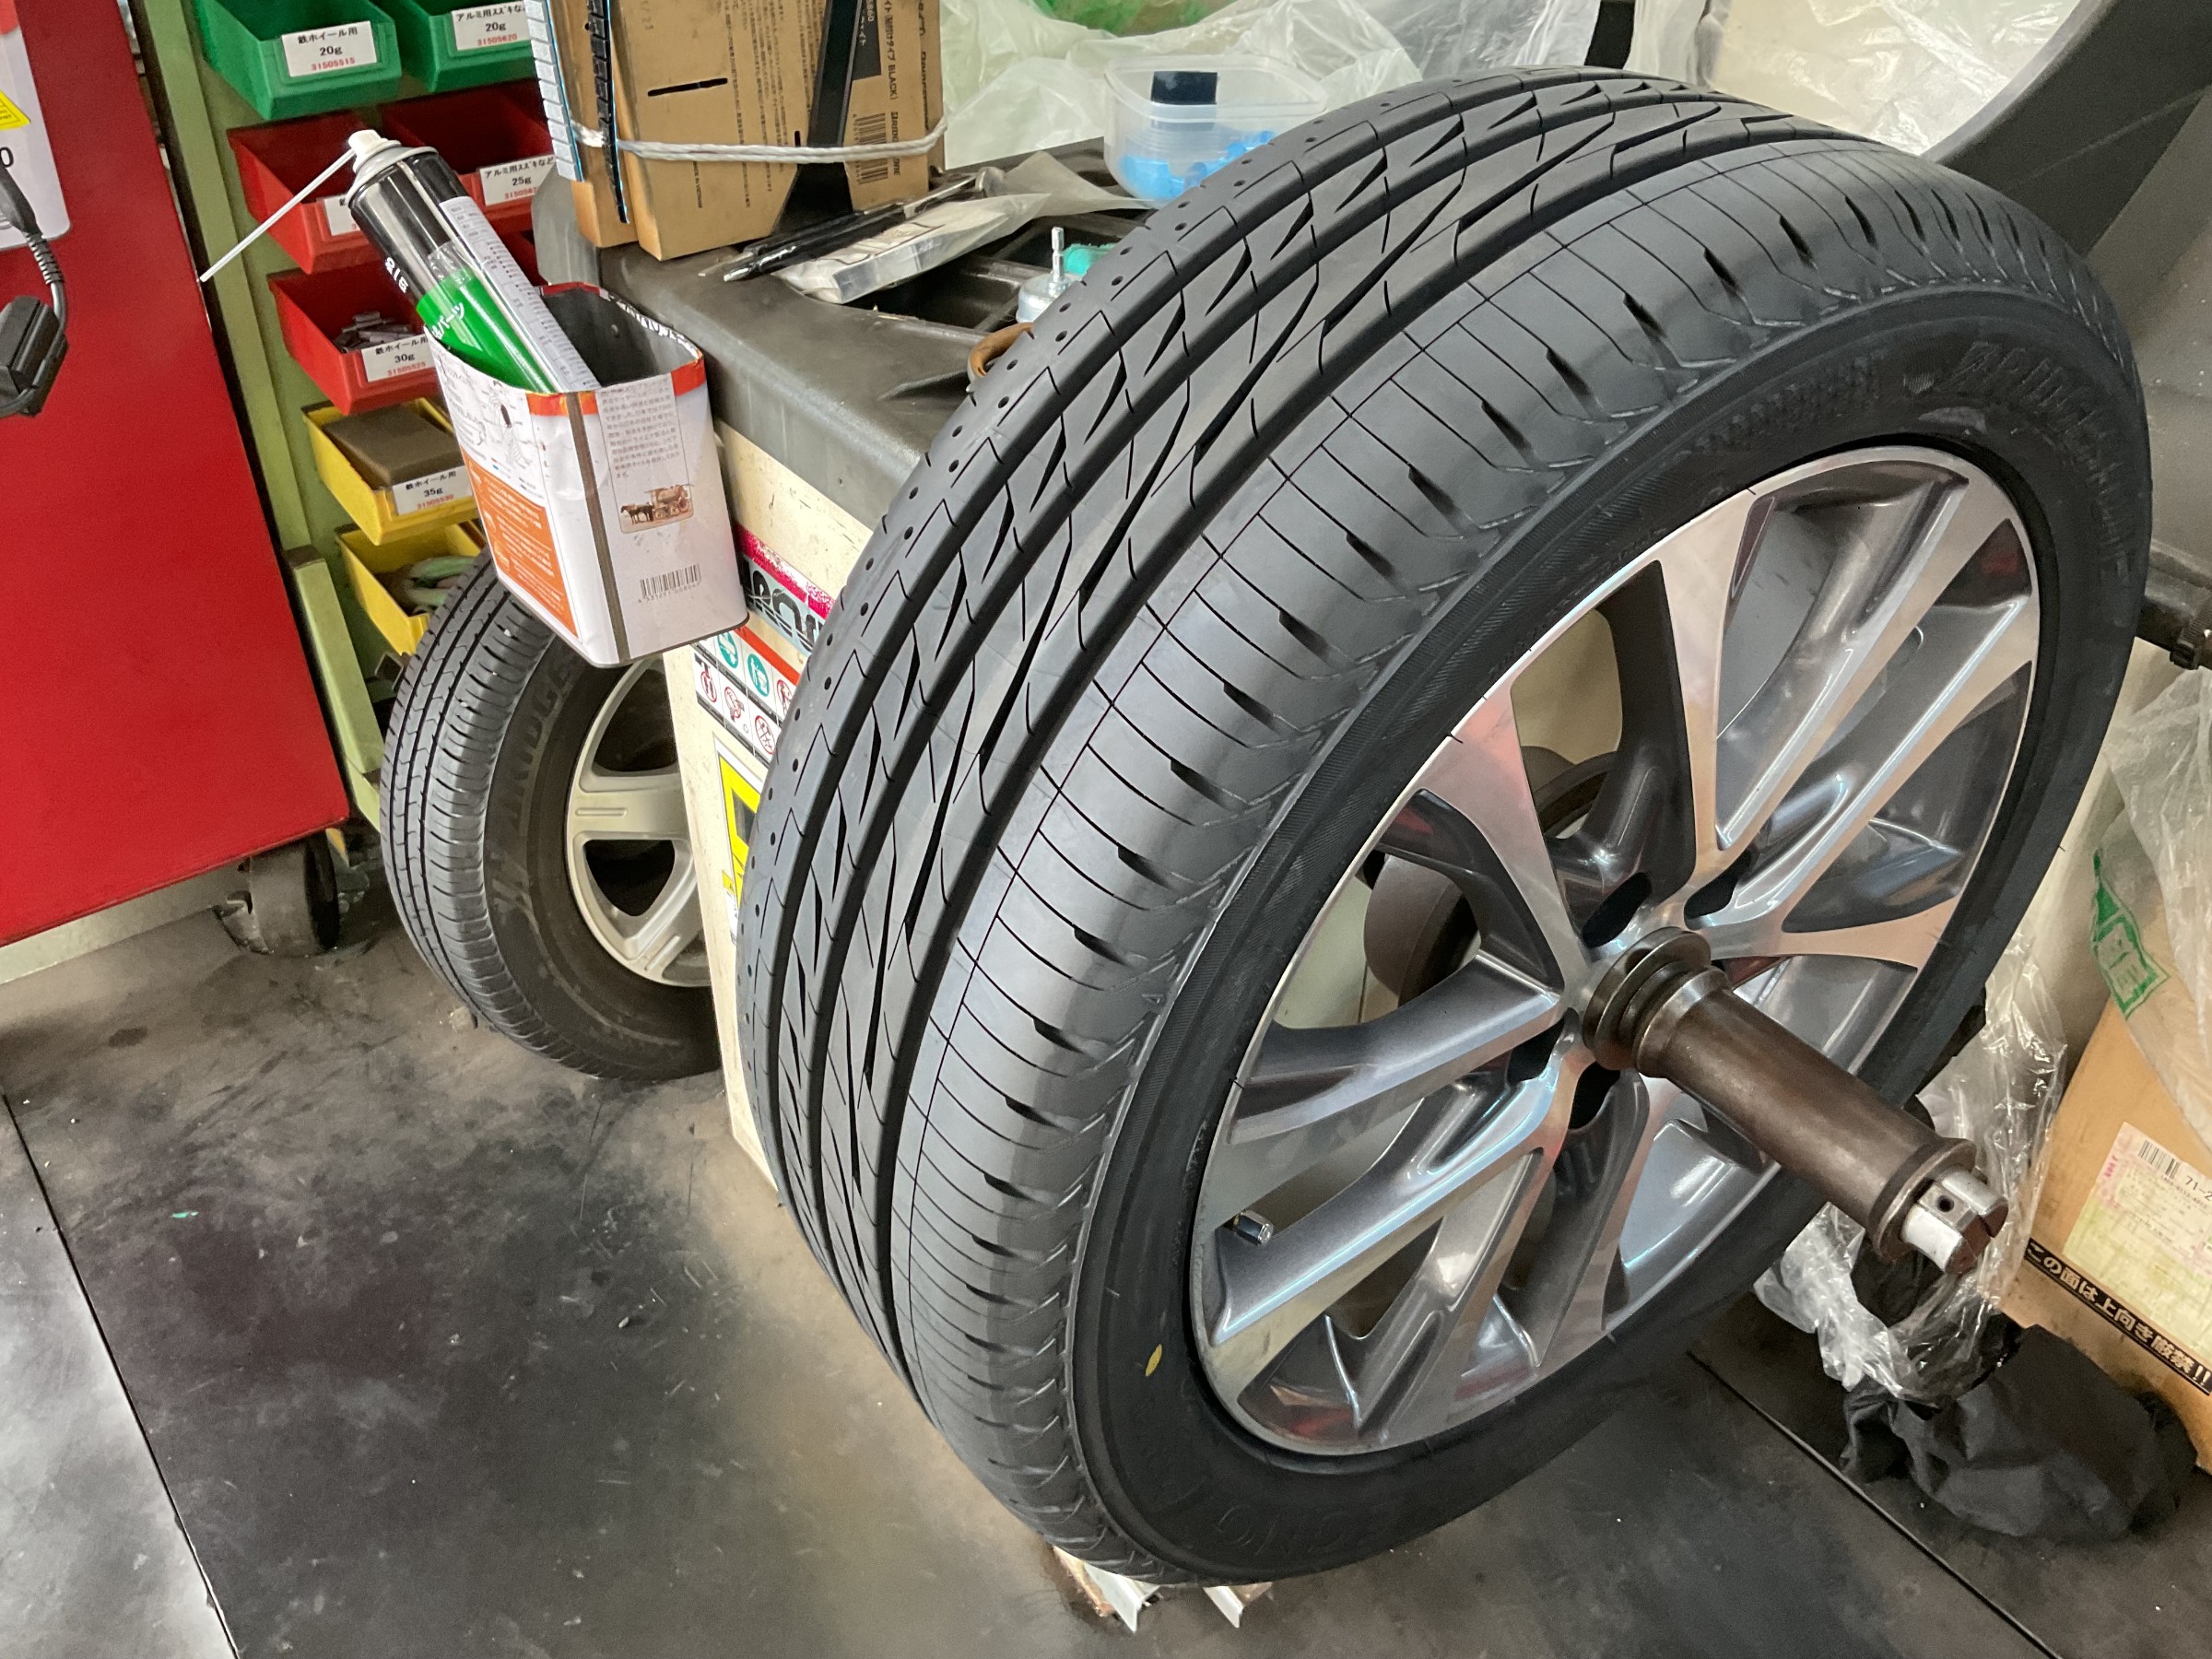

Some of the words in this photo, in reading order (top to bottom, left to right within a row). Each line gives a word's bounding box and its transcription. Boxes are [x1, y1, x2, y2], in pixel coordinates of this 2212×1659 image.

[485, 22, 507, 32] 20g
[297, 27, 358, 44] 鉄ホイール用
[319, 45, 343, 56] 20g
[311, 57, 356, 71] 31505515
[512, 176, 532, 186] 25g
[394, 353, 415, 363] 30g
[424, 488, 443, 498] 35g
